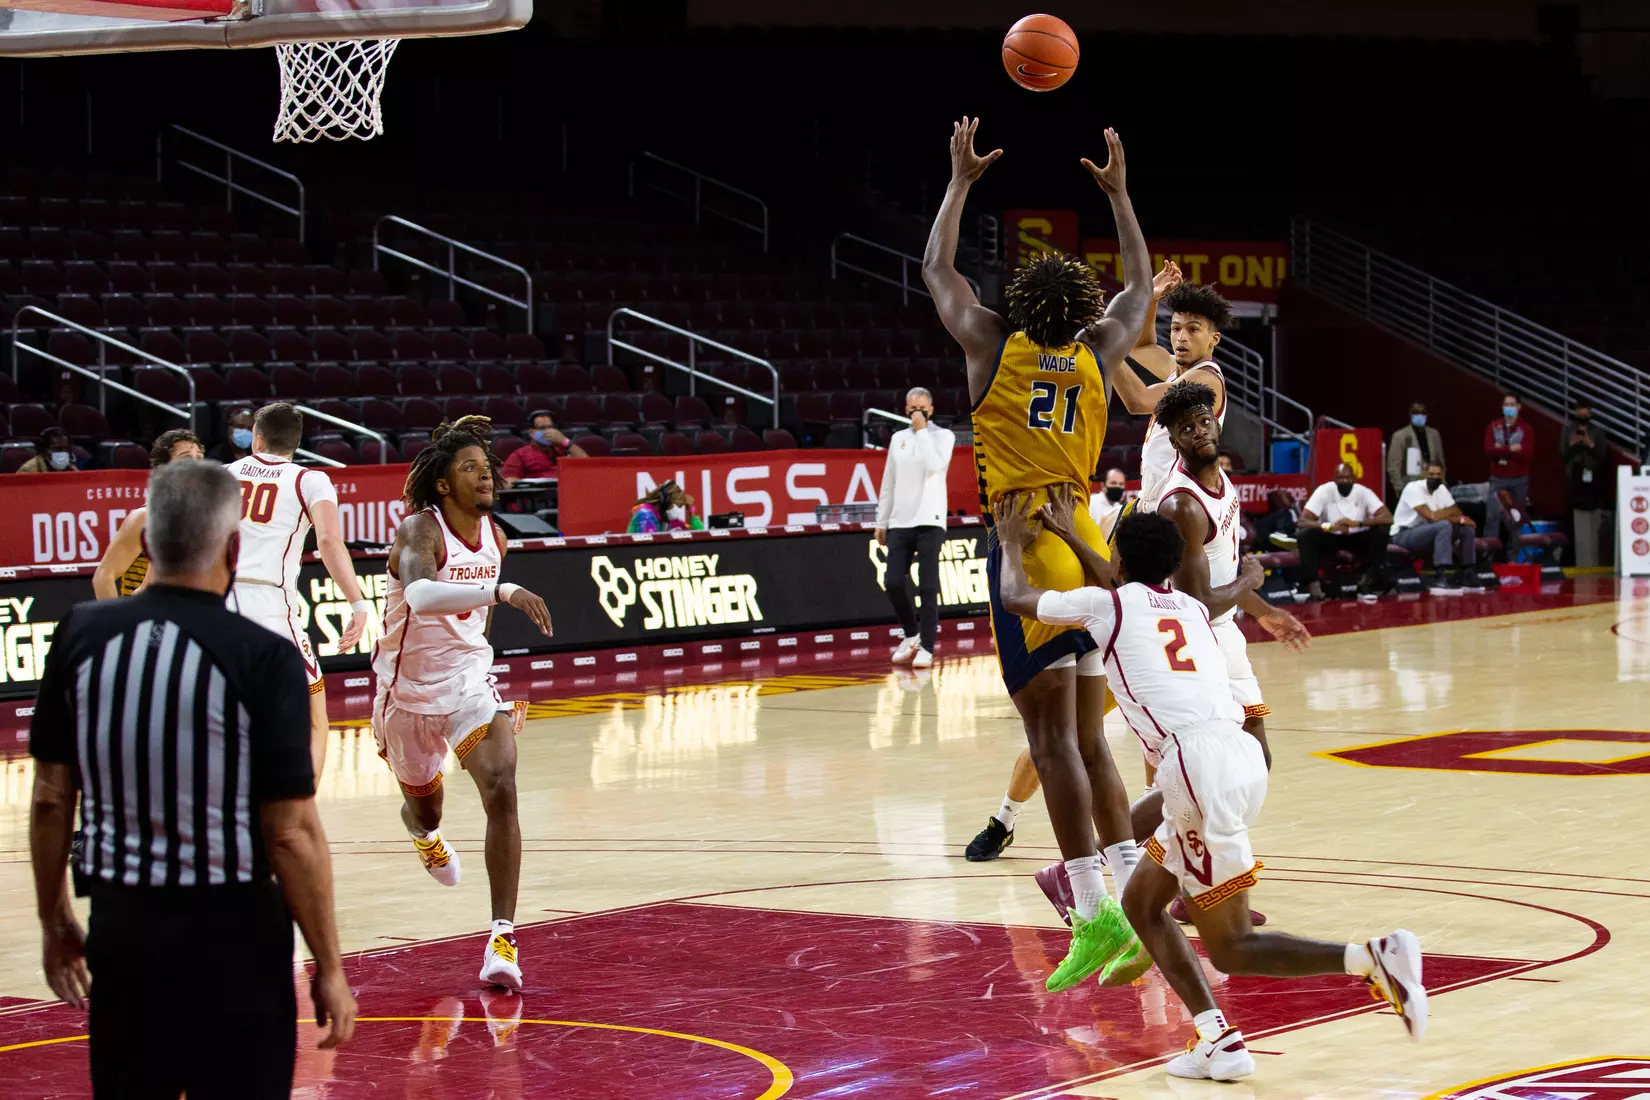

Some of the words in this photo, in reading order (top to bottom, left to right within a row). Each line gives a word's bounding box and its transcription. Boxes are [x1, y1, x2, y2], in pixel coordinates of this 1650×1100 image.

[1038, 353, 1076, 373] WADE
[1027, 380, 1082, 434] 21
[240, 463, 283, 479] BAUMANN
[635, 462, 880, 530] NISSA
[32, 510, 99, 563] DOS
[449, 565, 497, 580] TROJANS
[634, 553, 719, 581] HONEY
[639, 574, 763, 630] STINGER
[1157, 616, 1197, 672] 2
